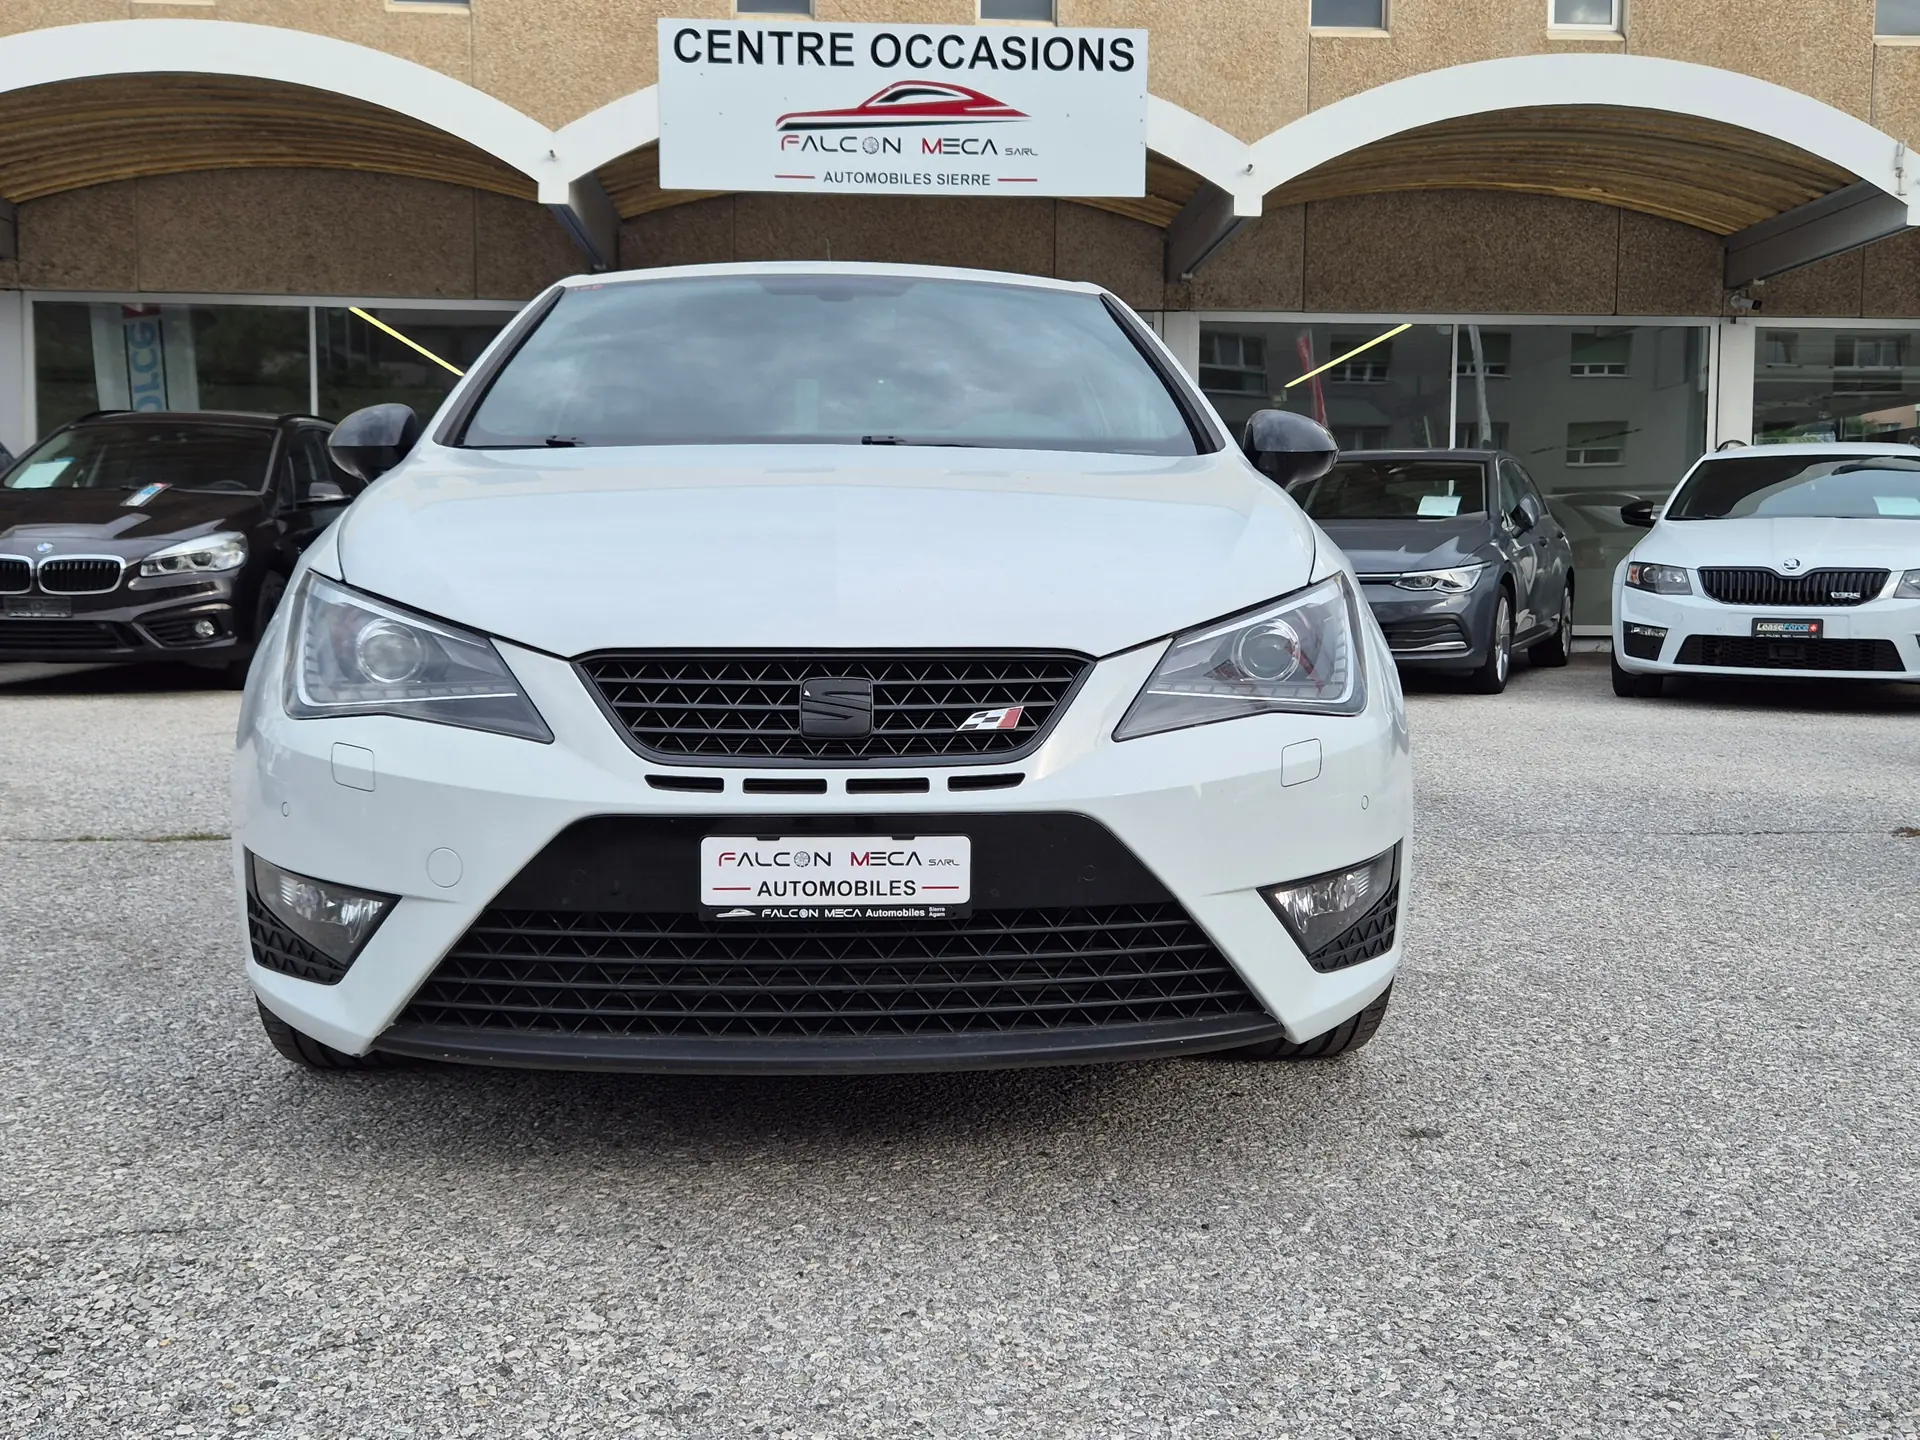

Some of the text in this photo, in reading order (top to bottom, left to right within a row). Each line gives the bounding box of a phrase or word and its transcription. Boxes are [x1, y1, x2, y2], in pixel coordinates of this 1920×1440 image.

[673, 28, 1135, 72] CENTRE OCCASIONS
[781, 135, 1038, 157] FALCON MECA SARL
[823, 171, 991, 186] AUTOMOBILES SIERRE
[718, 851, 960, 868] FALCON MECA SARL
[757, 880, 917, 897] AUTOMOBILES
[761, 908, 925, 919] FALCON MECA Automobiles
